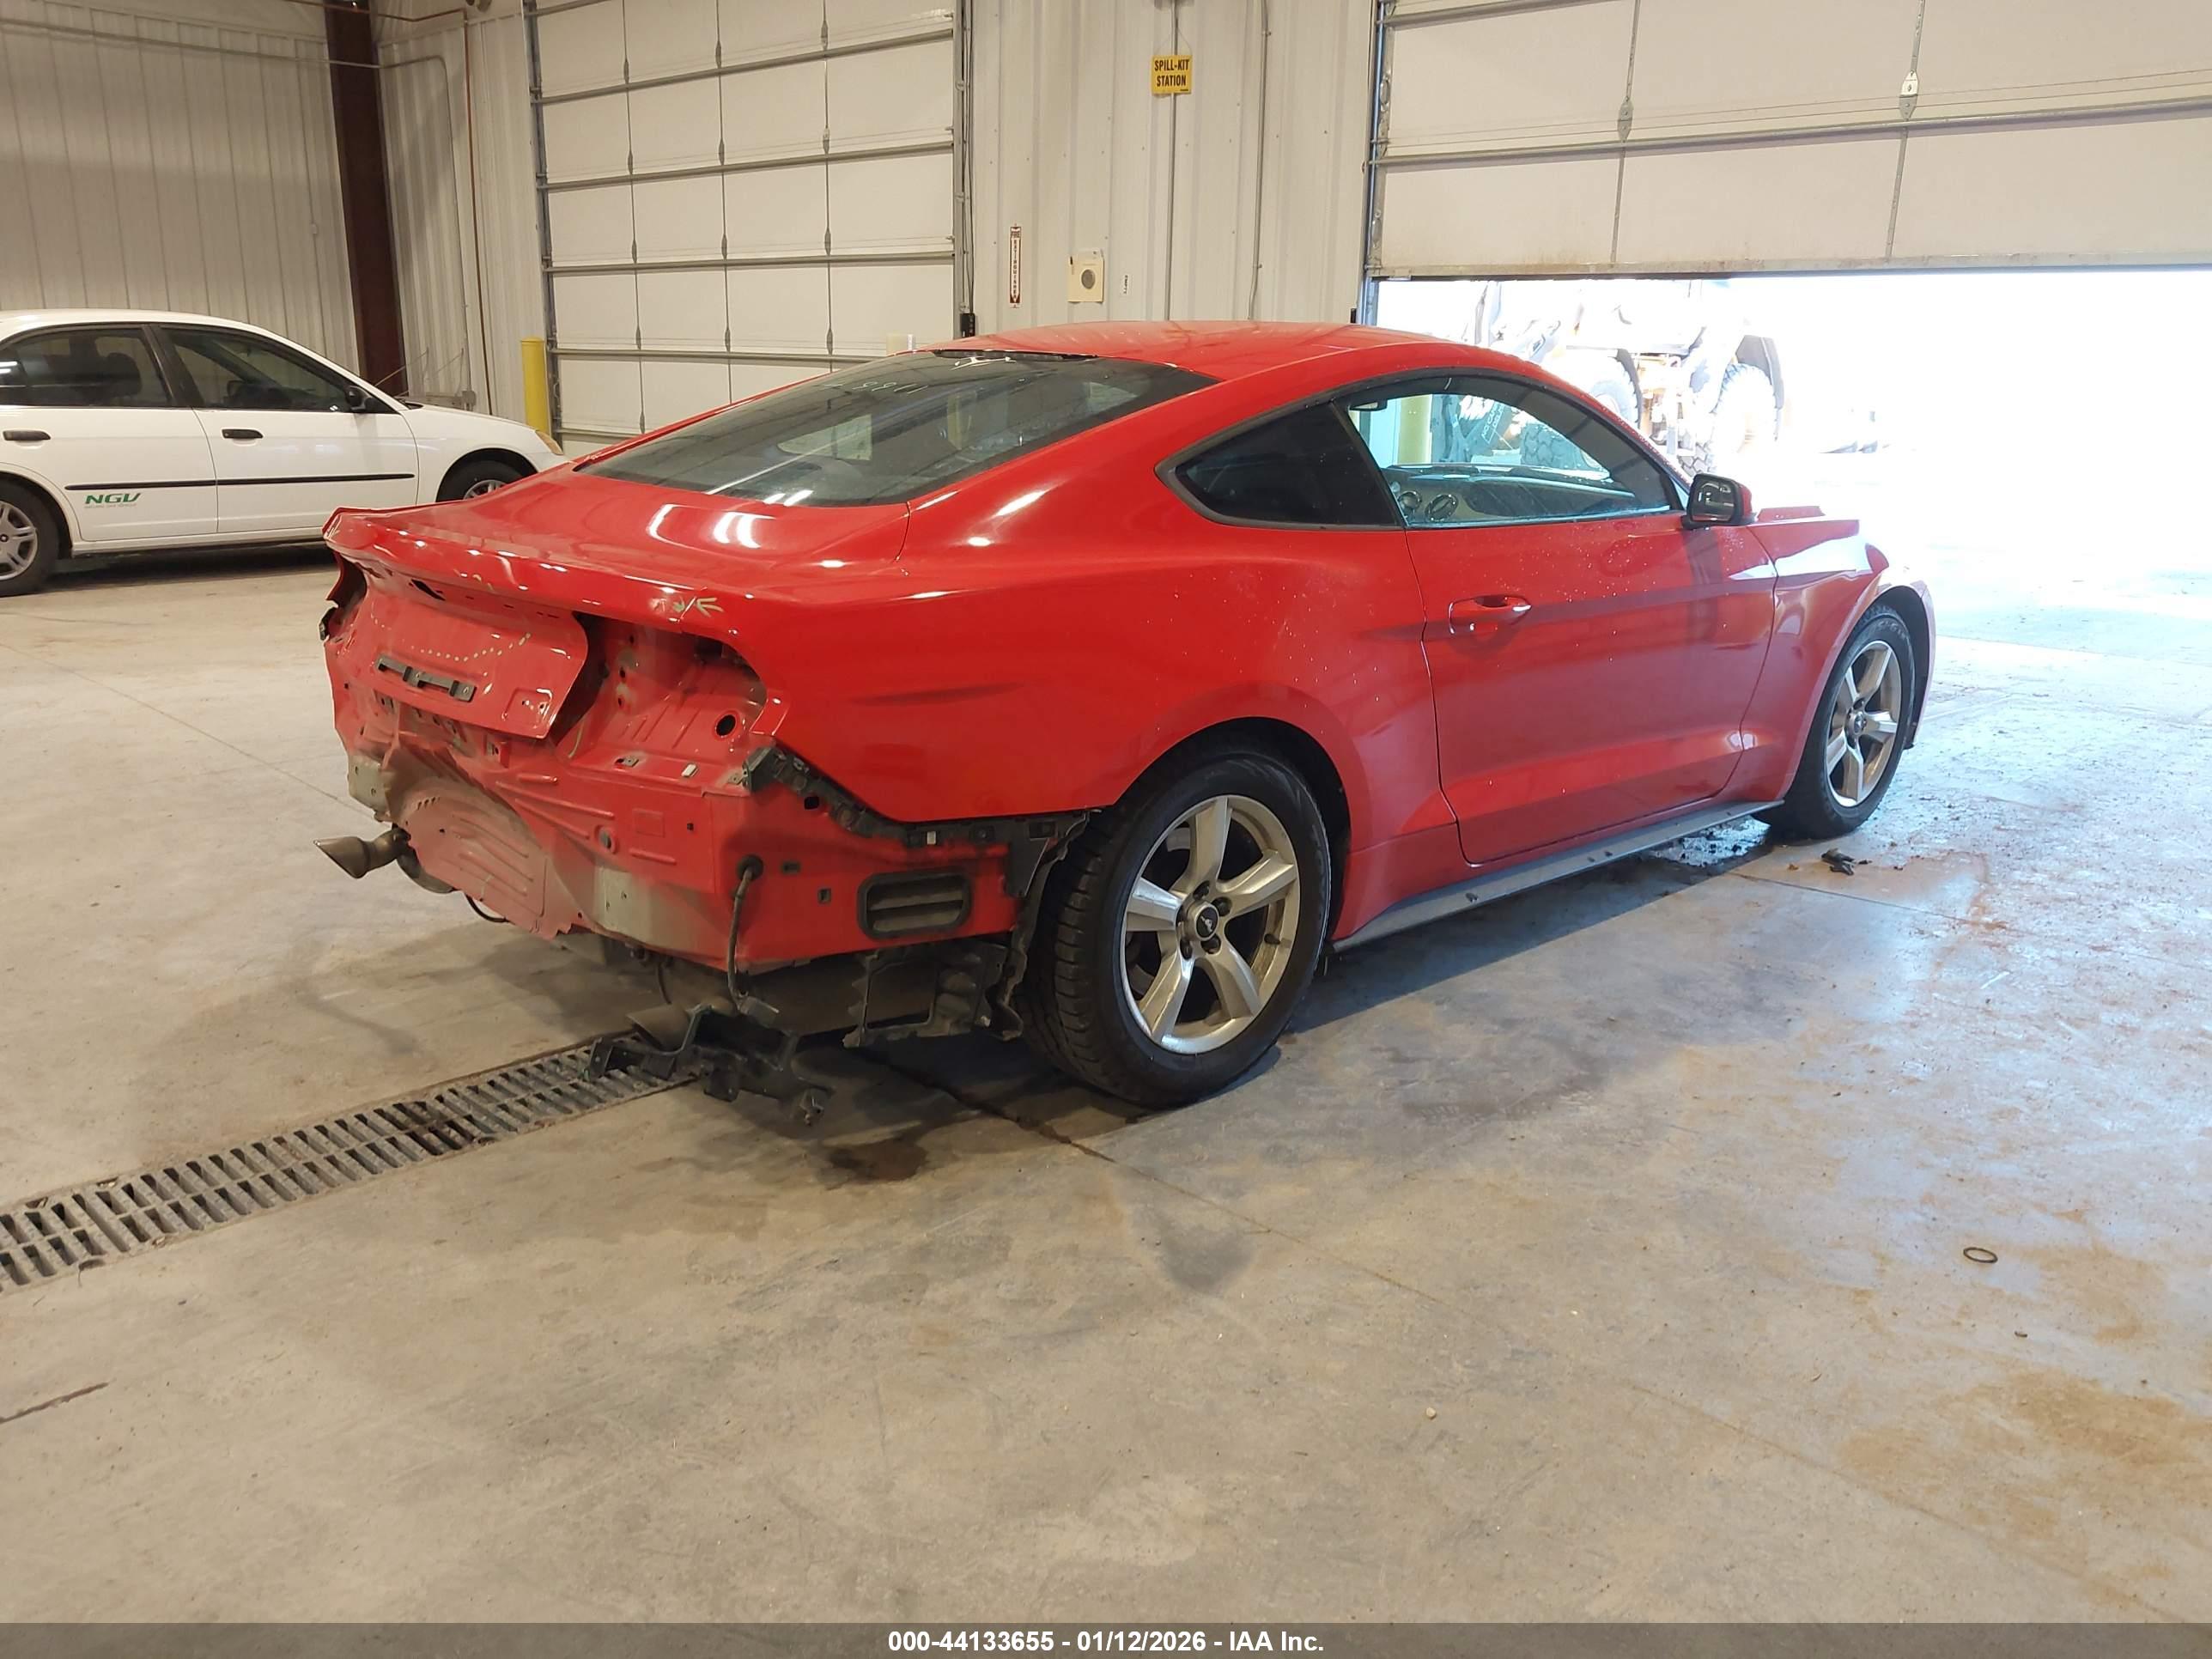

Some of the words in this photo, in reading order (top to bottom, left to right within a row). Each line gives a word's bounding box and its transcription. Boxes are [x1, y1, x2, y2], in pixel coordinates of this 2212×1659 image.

[1154, 59, 1189, 71] SPILL-KIT
[1157, 75, 1186, 87] STATION
[85, 493, 141, 504] NGV
